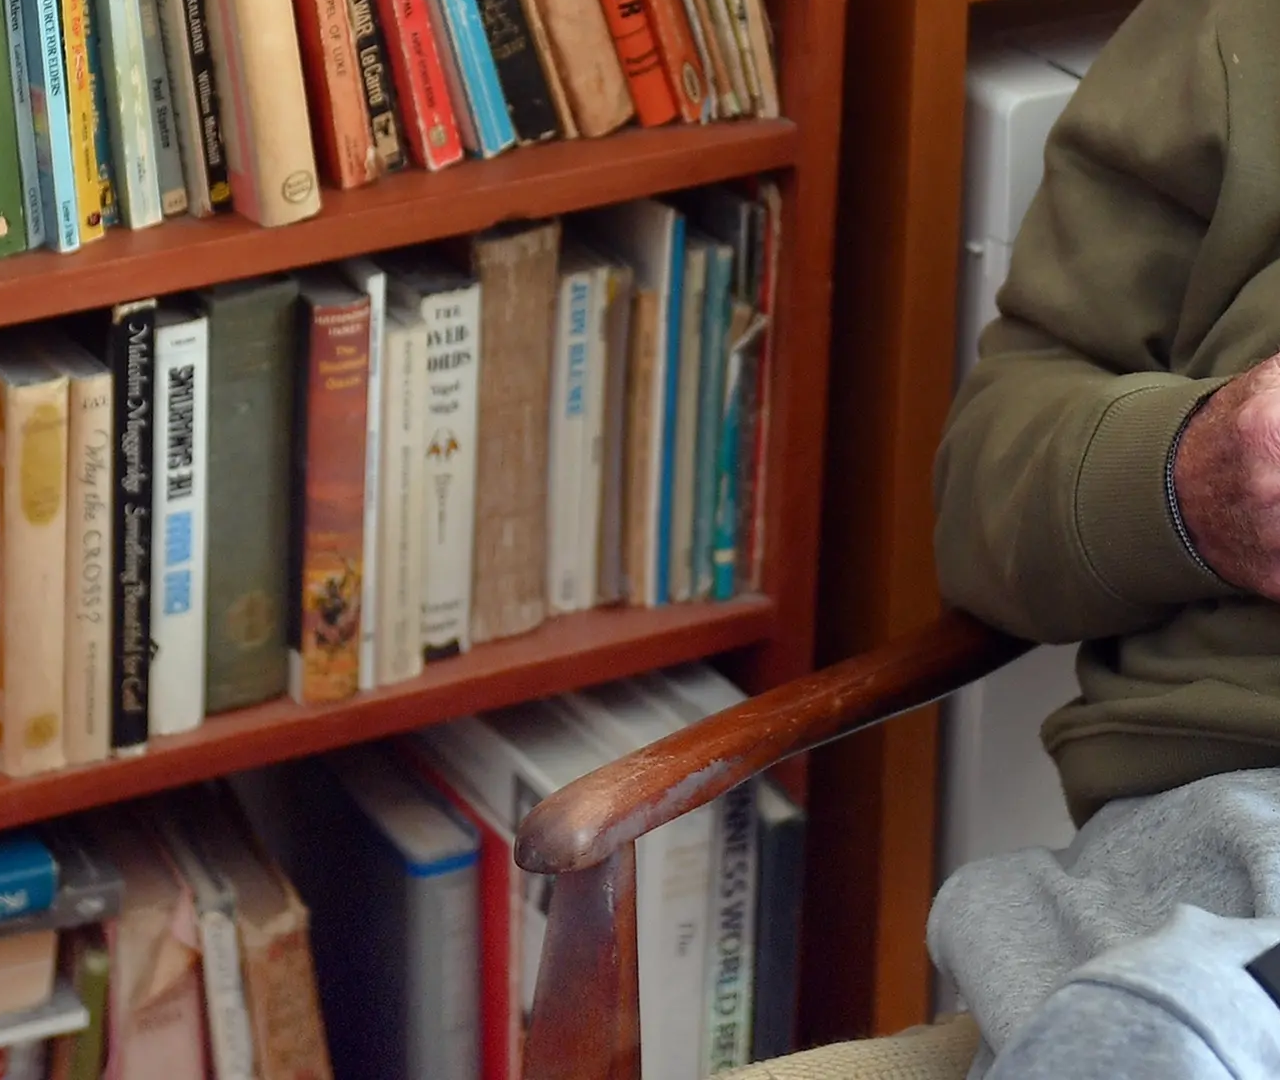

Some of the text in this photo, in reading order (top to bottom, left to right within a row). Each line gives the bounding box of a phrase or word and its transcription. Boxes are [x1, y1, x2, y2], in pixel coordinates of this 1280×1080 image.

[329, 24, 341, 40] OF
[332, 45, 347, 77] LUKE
[50, 56, 62, 97] ELDERS
[126, 322, 148, 398] Malcolm
[121, 398, 148, 494] Muggeridge
[167, 364, 195, 469] SAMARITANS
[82, 427, 108, 486] Why
[166, 469, 194, 503] THE
[83, 493, 106, 521] the
[121, 502, 147, 584] Something
[720, 788, 751, 900] NNESS
[714, 900, 746, 1016] WORLD
